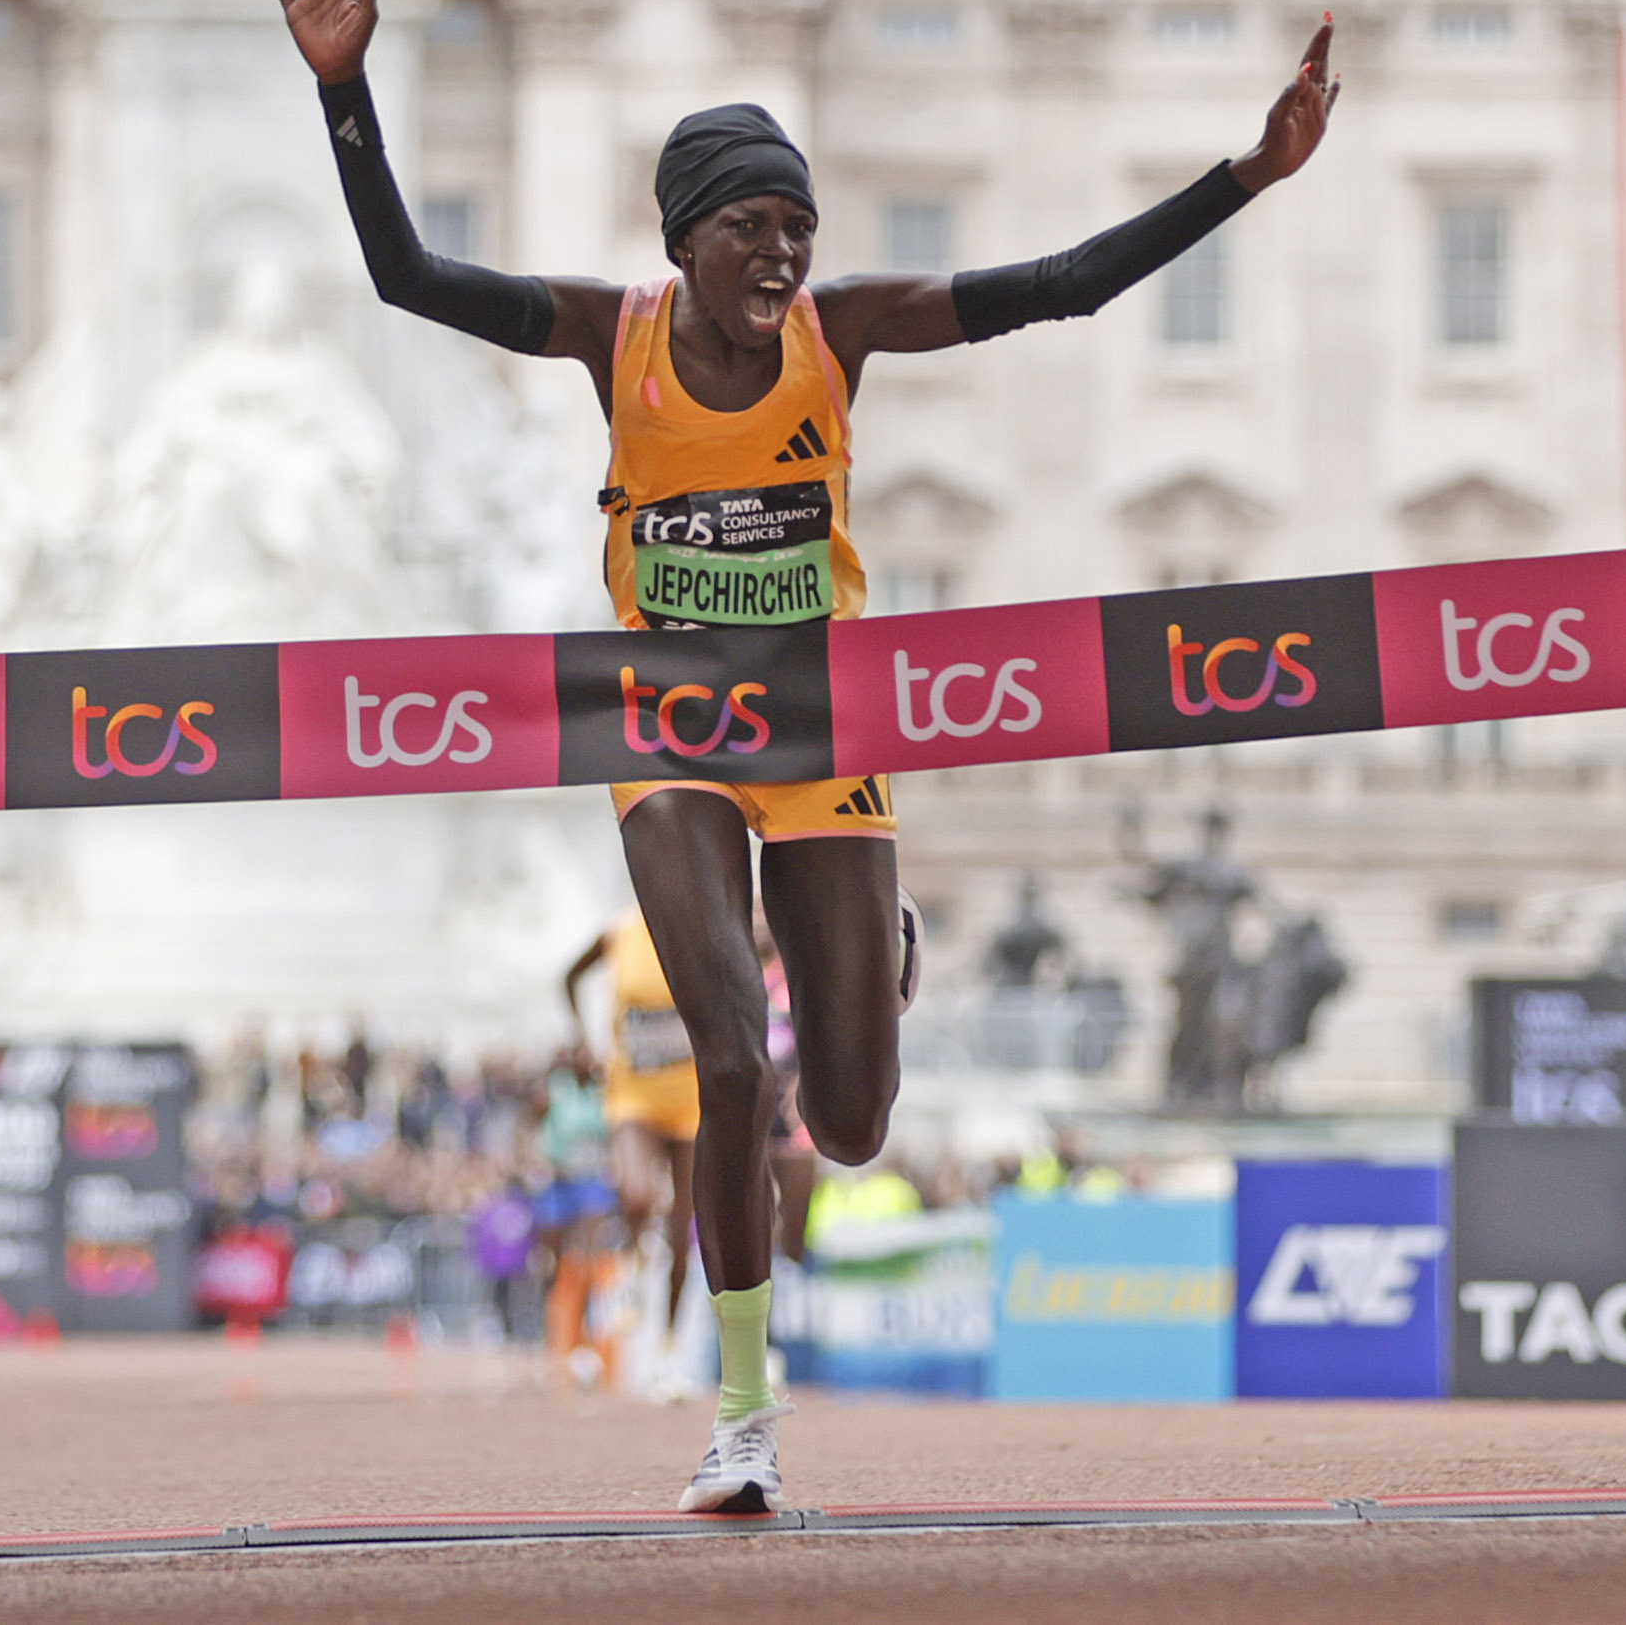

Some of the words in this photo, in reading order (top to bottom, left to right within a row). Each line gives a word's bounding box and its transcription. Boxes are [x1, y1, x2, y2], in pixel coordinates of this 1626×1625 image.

[719, 498, 764, 514] TATA
[720, 507, 821, 531] CONSULTANCY
[643, 511, 715, 546] tcs
[721, 525, 786, 546] SERVICES
[644, 561, 824, 616] JEPCHIRCHIR
[72, 686, 218, 779] tcs
[344, 675, 493, 769] tcs
[619, 665, 771, 757] tcs
[893, 649, 1043, 742] tcs
[1167, 623, 1317, 717] tcs
[1440, 599, 1591, 691] tcs
